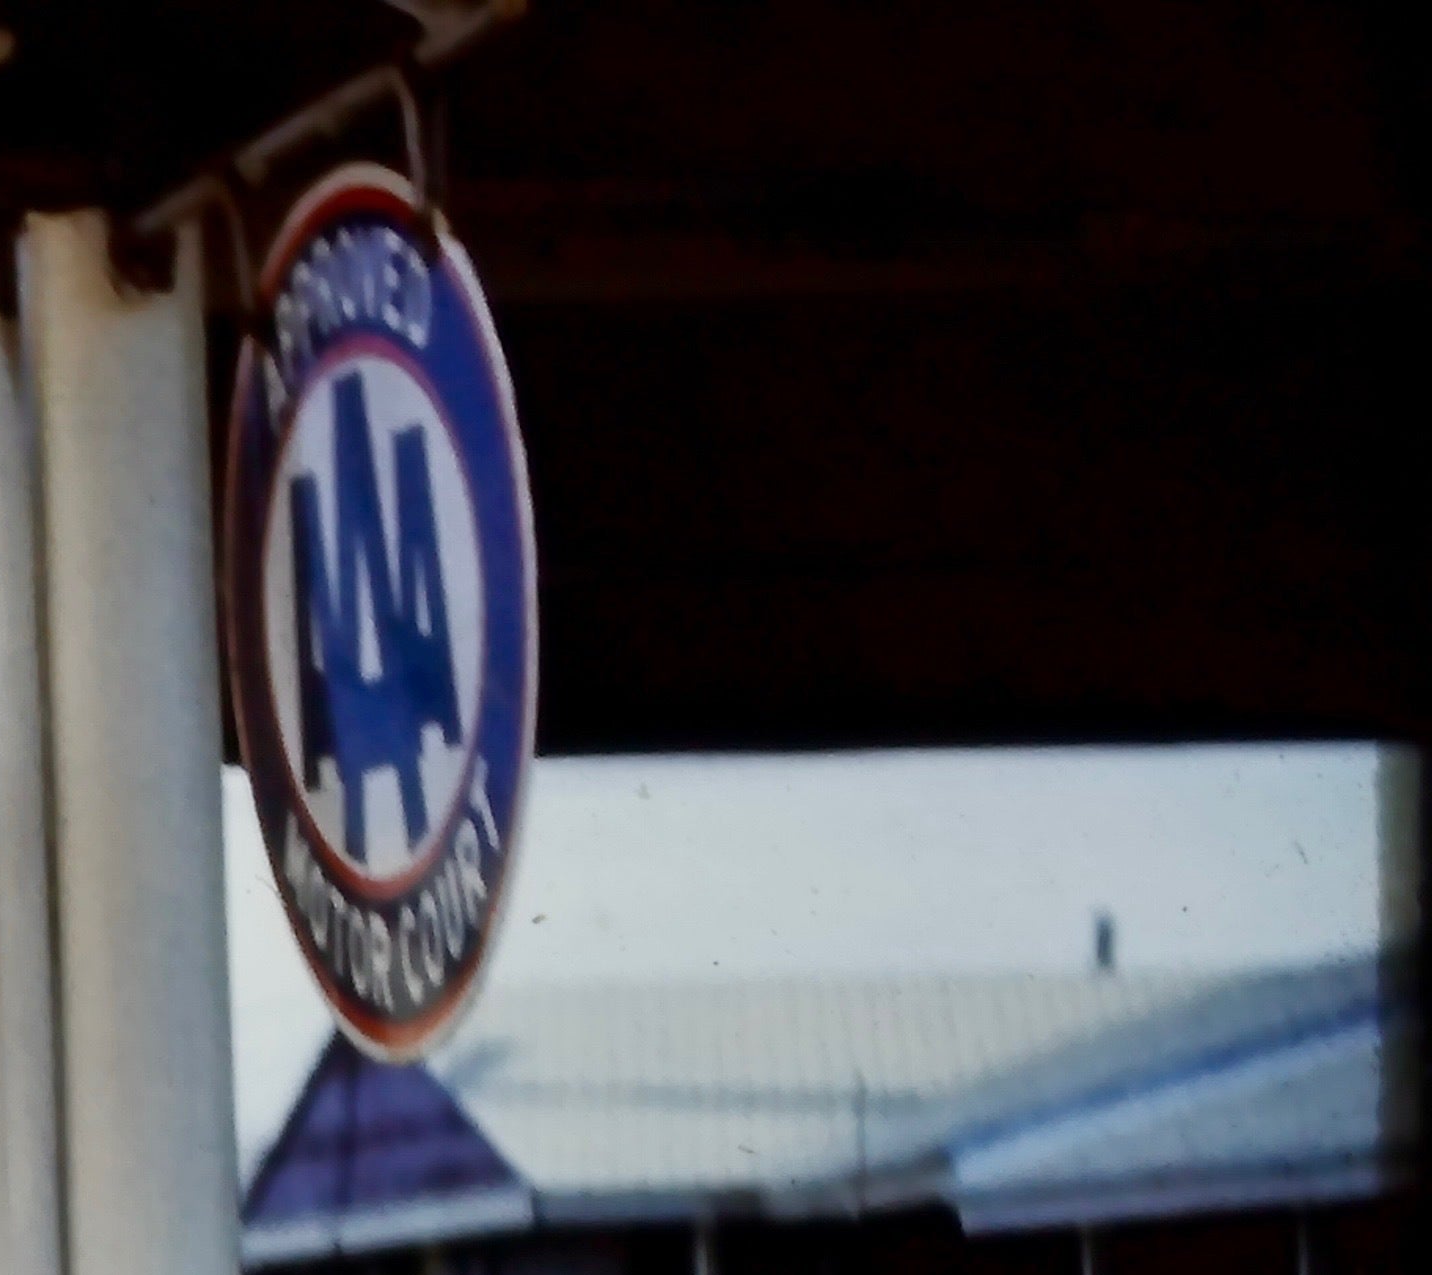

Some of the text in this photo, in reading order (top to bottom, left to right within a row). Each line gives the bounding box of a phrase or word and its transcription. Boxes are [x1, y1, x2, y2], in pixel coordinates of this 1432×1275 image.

[289, 372, 462, 865] AAA
[284, 755, 500, 1013] MOTOR COURT
